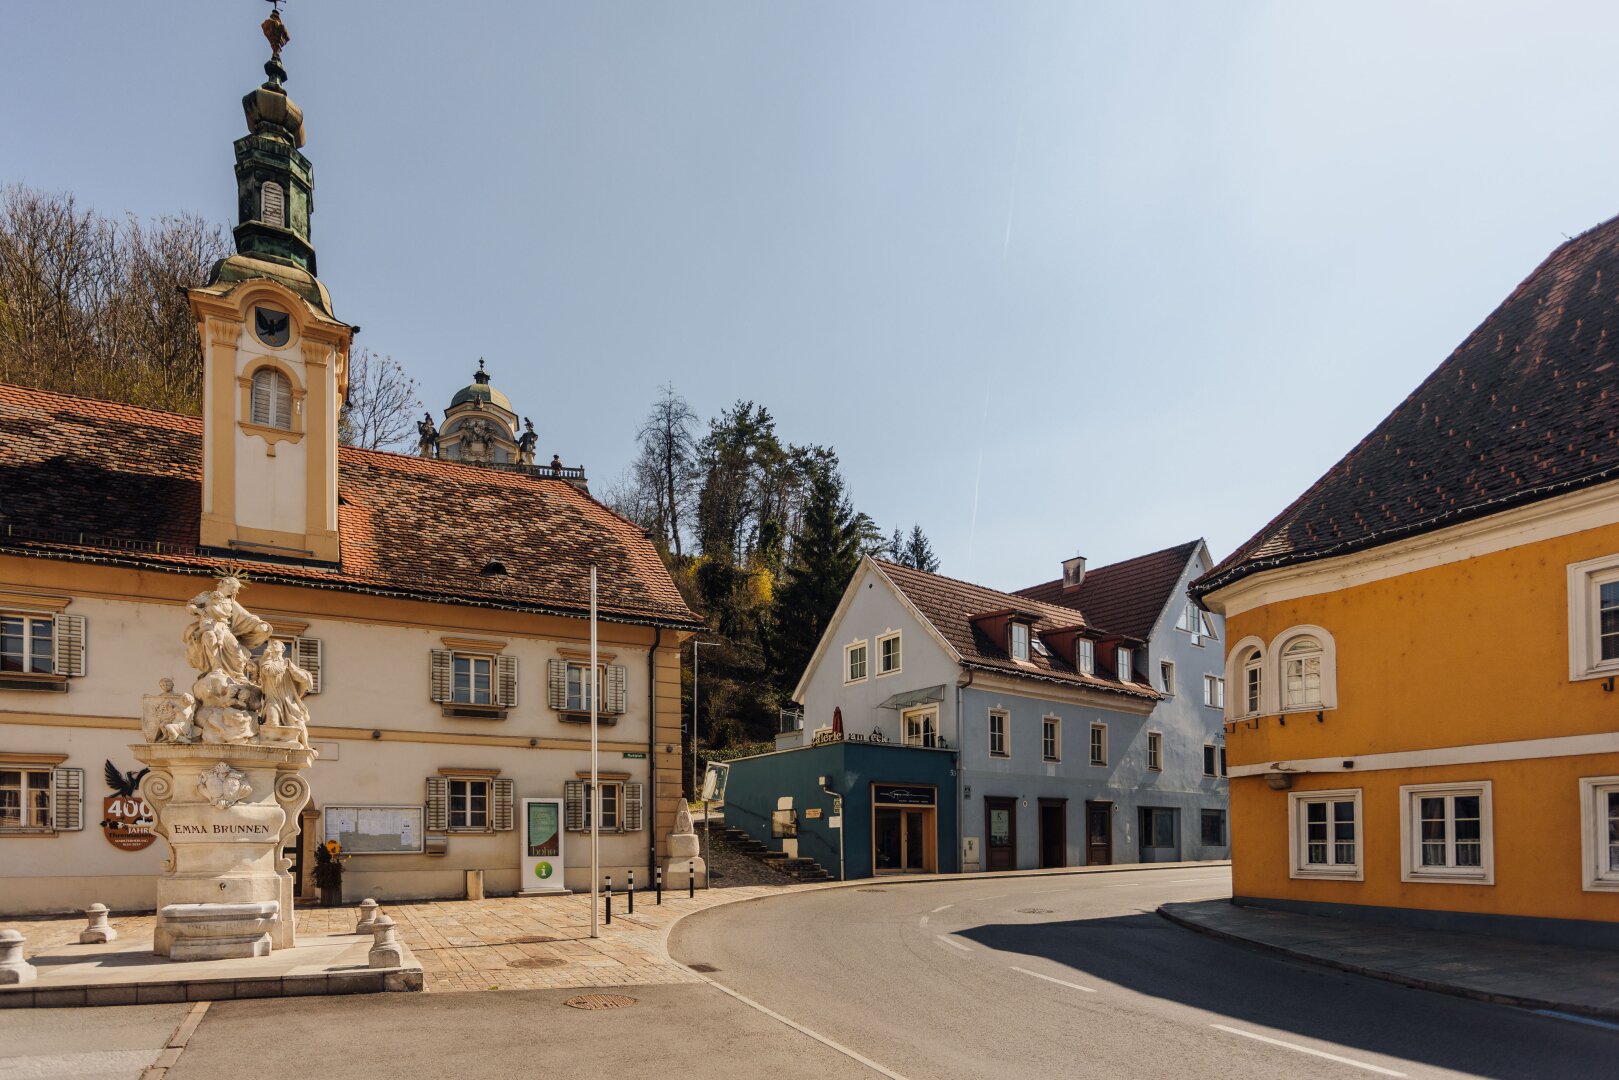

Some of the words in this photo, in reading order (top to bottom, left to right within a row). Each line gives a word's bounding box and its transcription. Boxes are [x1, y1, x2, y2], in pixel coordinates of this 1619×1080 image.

[107, 800, 153, 817] 400
[174, 824, 208, 834] EMMA
[212, 824, 270, 834] BRUNNEN
